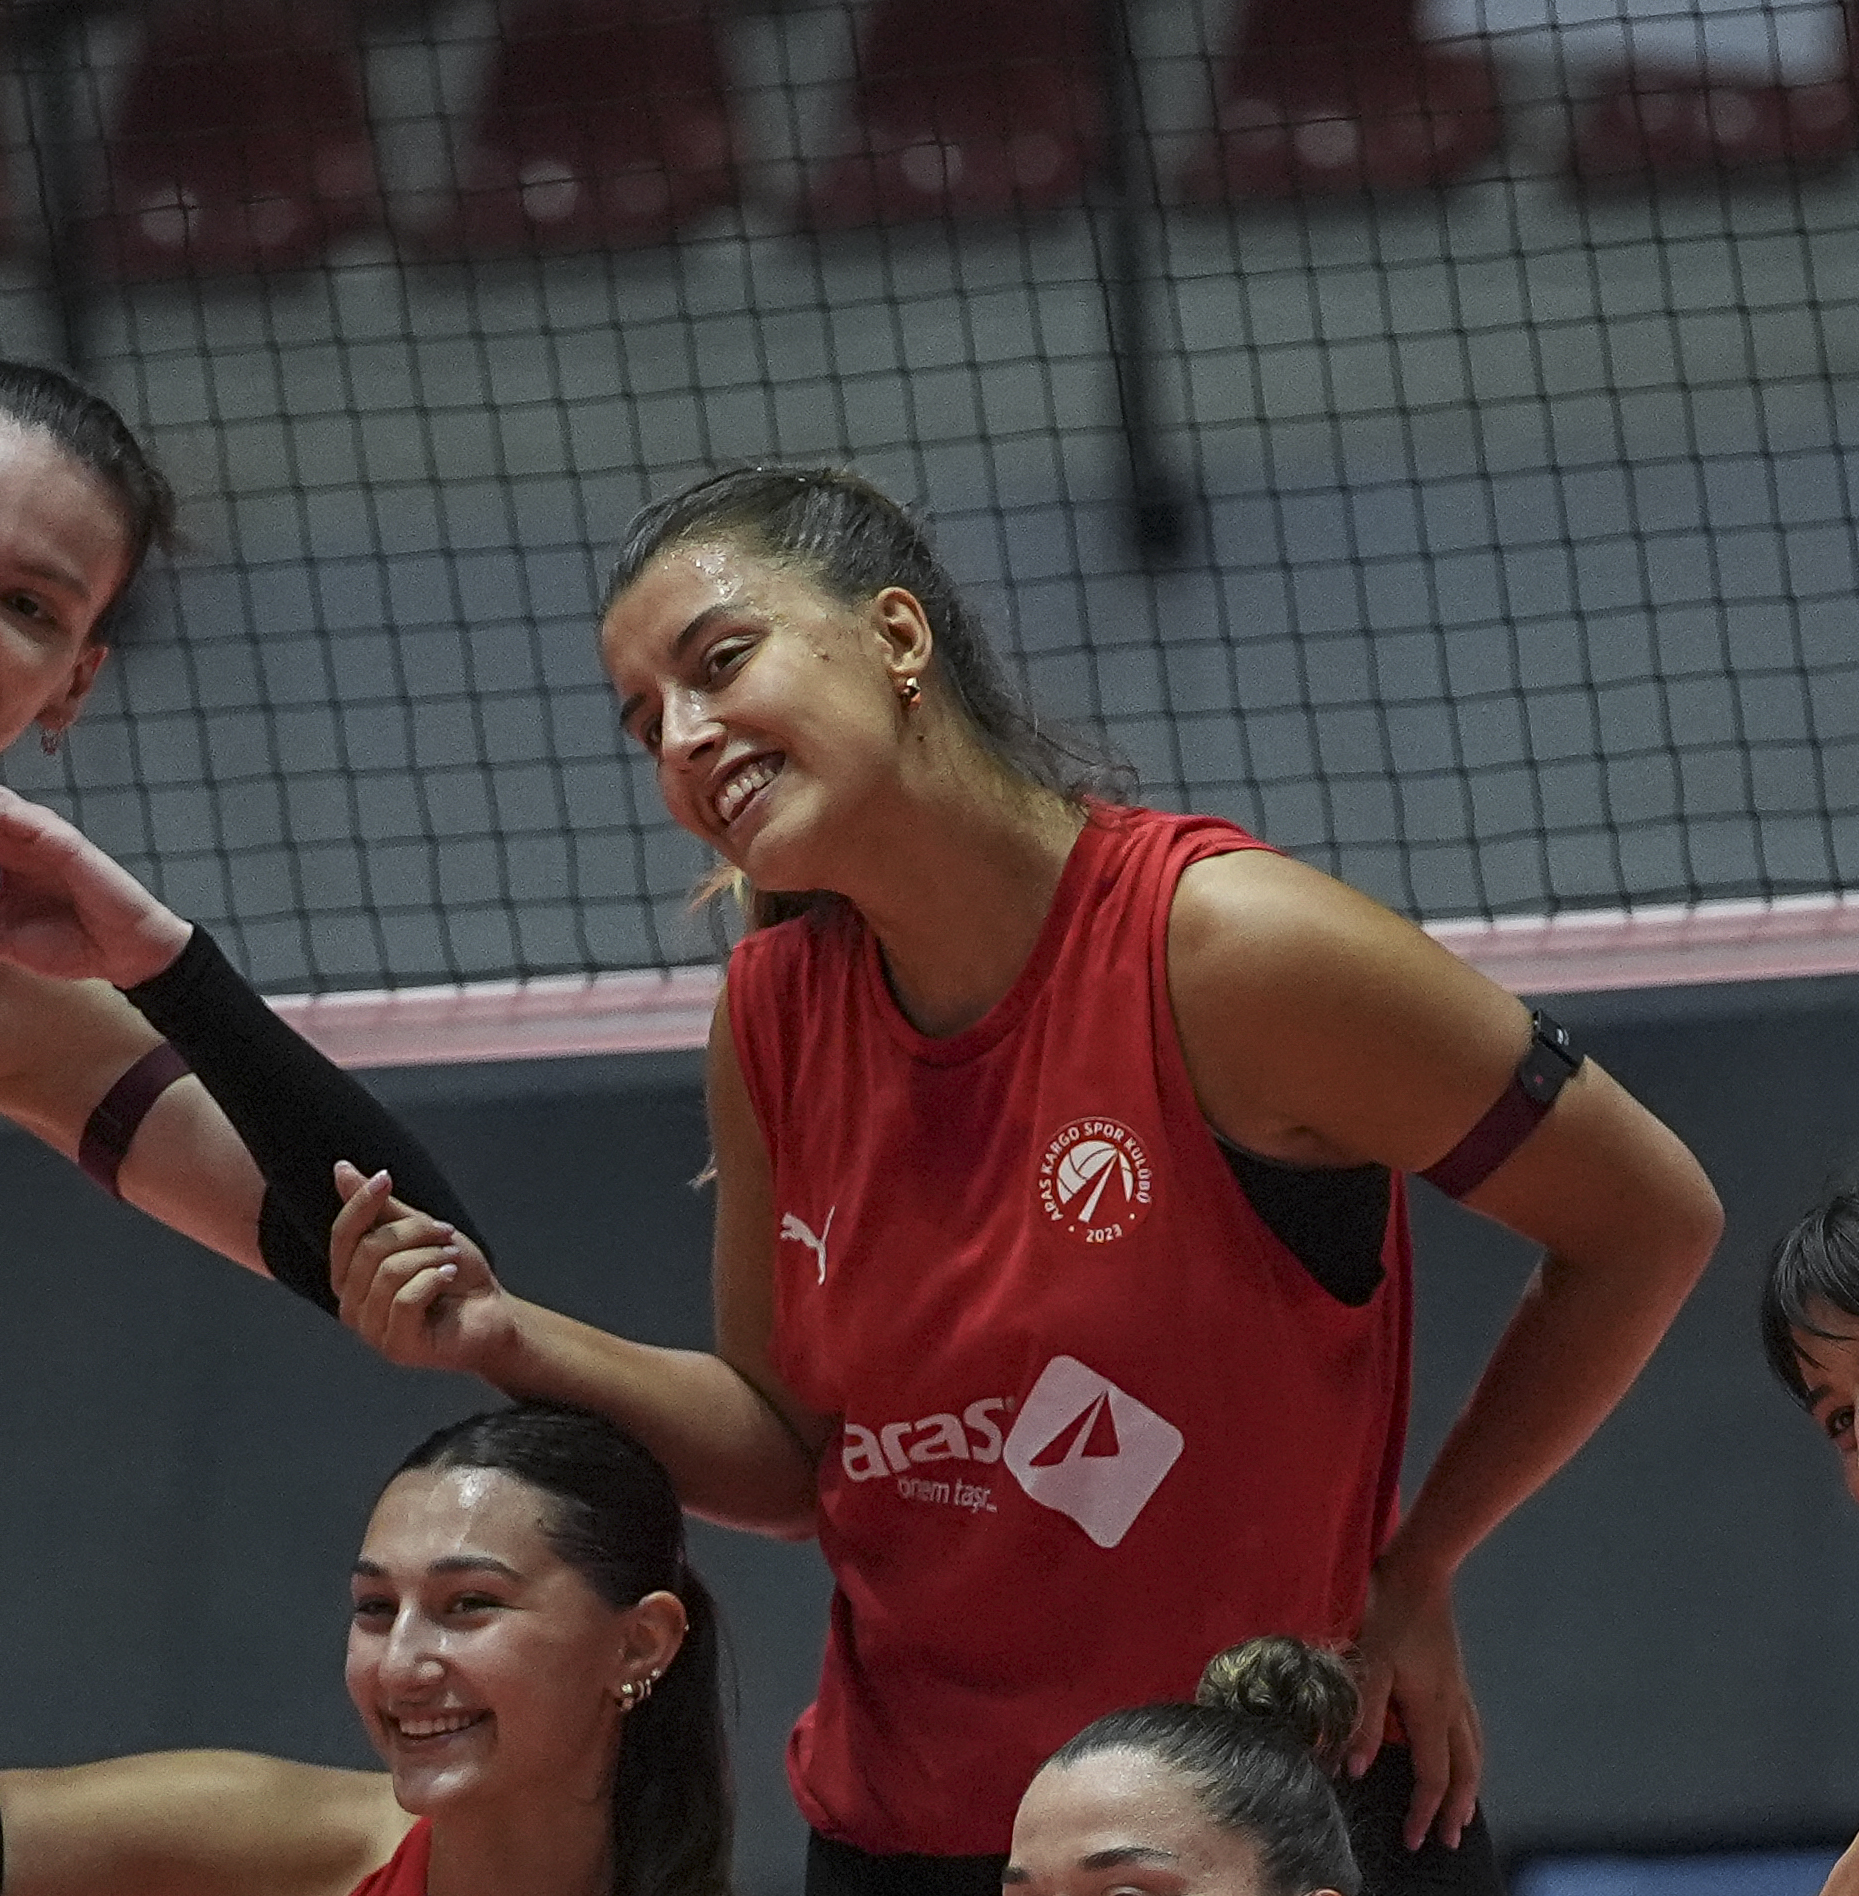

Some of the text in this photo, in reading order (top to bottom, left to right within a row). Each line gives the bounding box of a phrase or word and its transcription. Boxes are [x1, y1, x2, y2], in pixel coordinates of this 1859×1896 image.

[1041, 1126, 1081, 1176] KARGO
[1083, 1121, 1125, 1143] SPOR
[1039, 1178, 1064, 1221] ARAS
[1085, 1223, 1123, 1244] 2023
[842, 1397, 1005, 1483] aras
